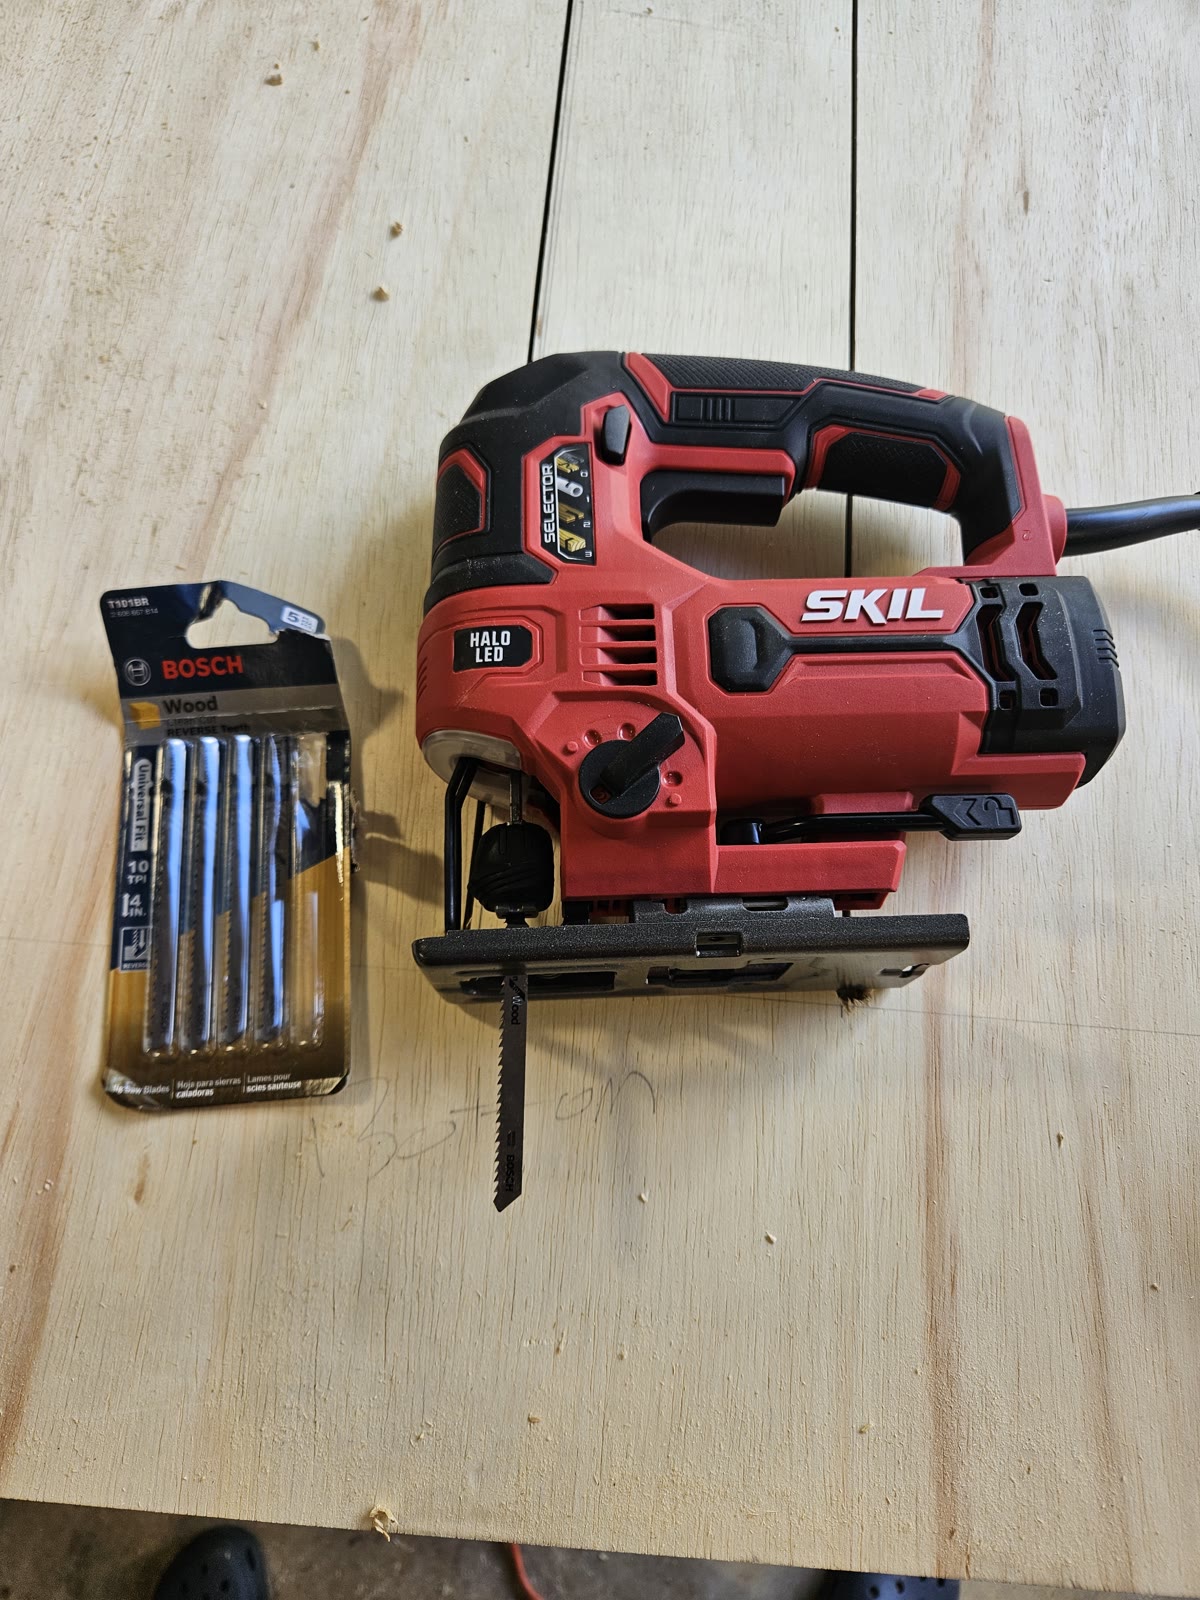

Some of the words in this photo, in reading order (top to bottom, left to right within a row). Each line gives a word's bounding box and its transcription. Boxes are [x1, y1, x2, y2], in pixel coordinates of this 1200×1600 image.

[541, 463, 556, 543] SELECTOR
[107, 597, 150, 609] T101BR
[801, 587, 944, 624] SKIL
[287, 611, 299, 623] 5
[470, 630, 511, 647] HALO
[475, 646, 504, 663] LED
[162, 655, 244, 680] BOSCH
[163, 696, 218, 714] Wood
[167, 725, 219, 737] REVERSE
[134, 764, 149, 823] Universal
[134, 825, 147, 842] Fit
[128, 861, 149, 873] 10
[127, 875, 147, 884] TPI
[130, 894, 142, 908] 4
[510, 994, 521, 1025] Wood
[196, 1079, 214, 1090] para
[214, 1076, 242, 1086] sierras
[247, 1074, 272, 1083] Lames
[273, 1073, 291, 1082] pour
[143, 1084, 170, 1094] Blades
[246, 1084, 267, 1093] scies
[505, 1154, 515, 1193] BOSCH
